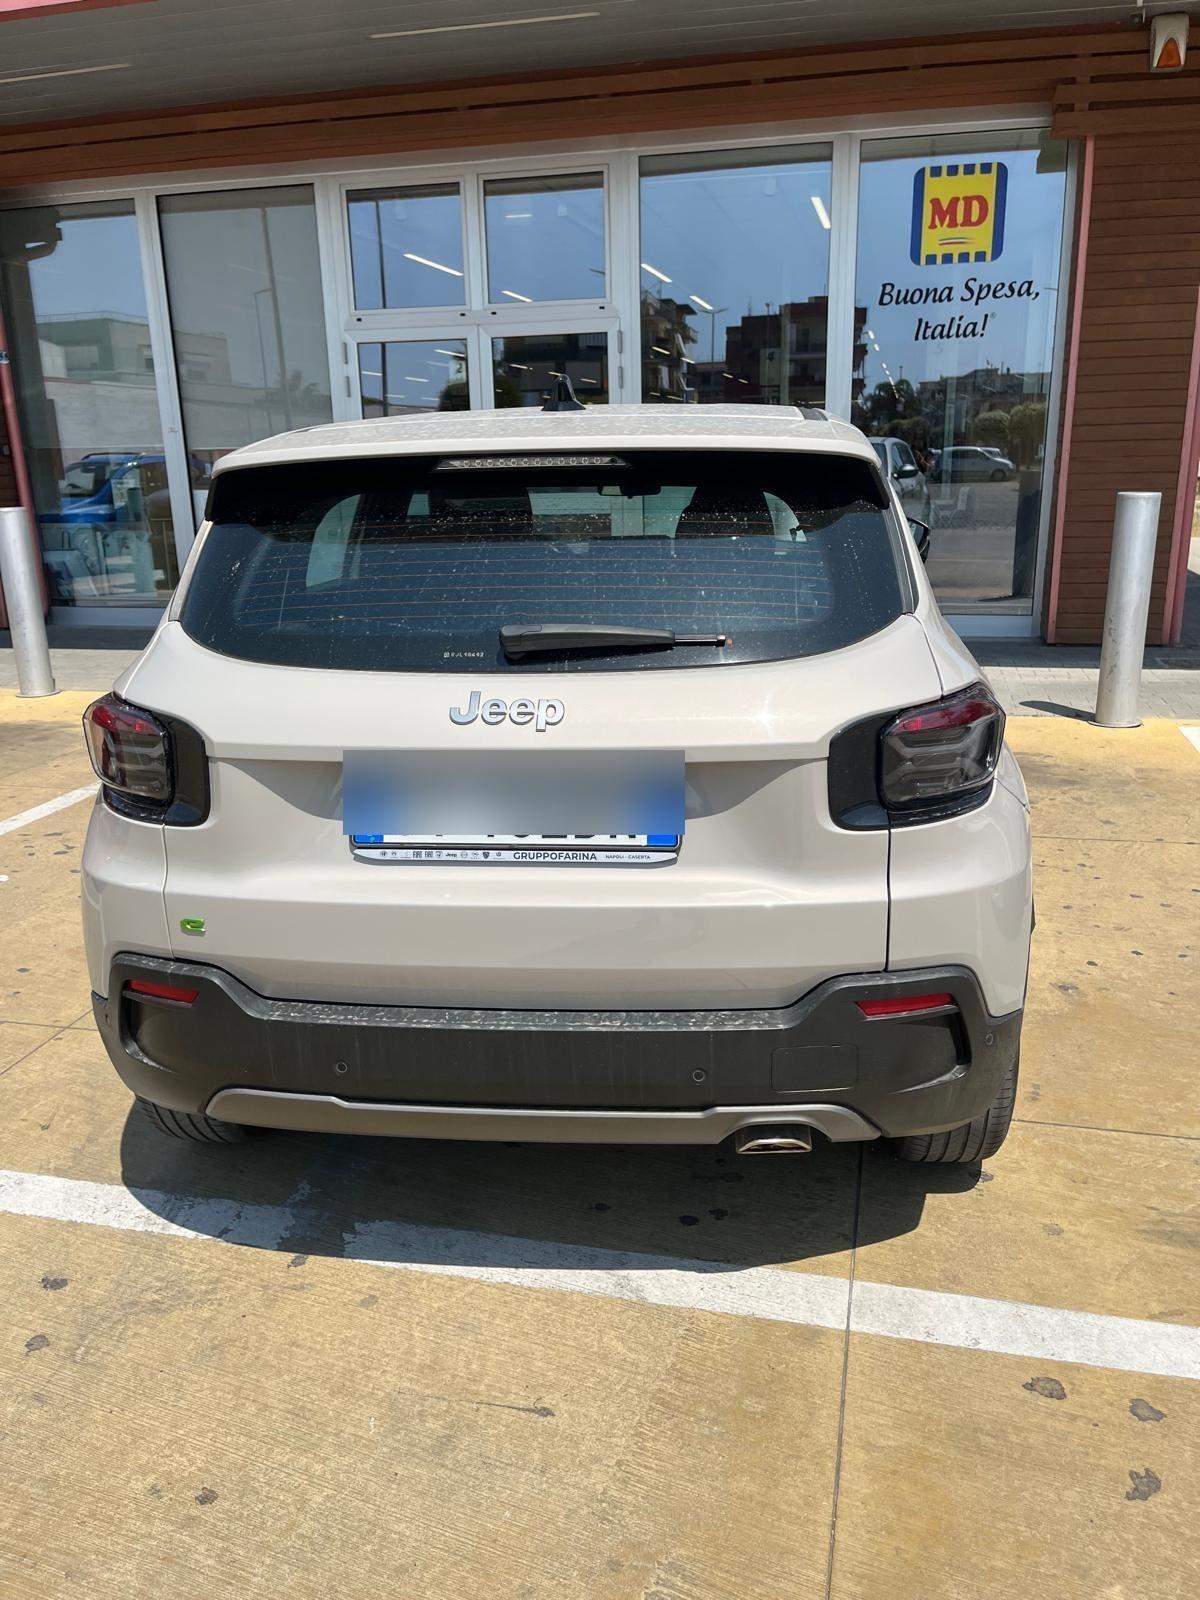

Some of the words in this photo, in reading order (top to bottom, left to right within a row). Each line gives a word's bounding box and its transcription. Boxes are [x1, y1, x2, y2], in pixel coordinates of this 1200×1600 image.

[928, 195, 989, 230] MD
[878, 282, 954, 306] Buona
[960, 278, 1040, 306] Spesa,
[914, 313, 989, 341] Italia!
[449, 691, 565, 732] Jeep
[513, 851, 597, 861] GRUPPOFARINA
